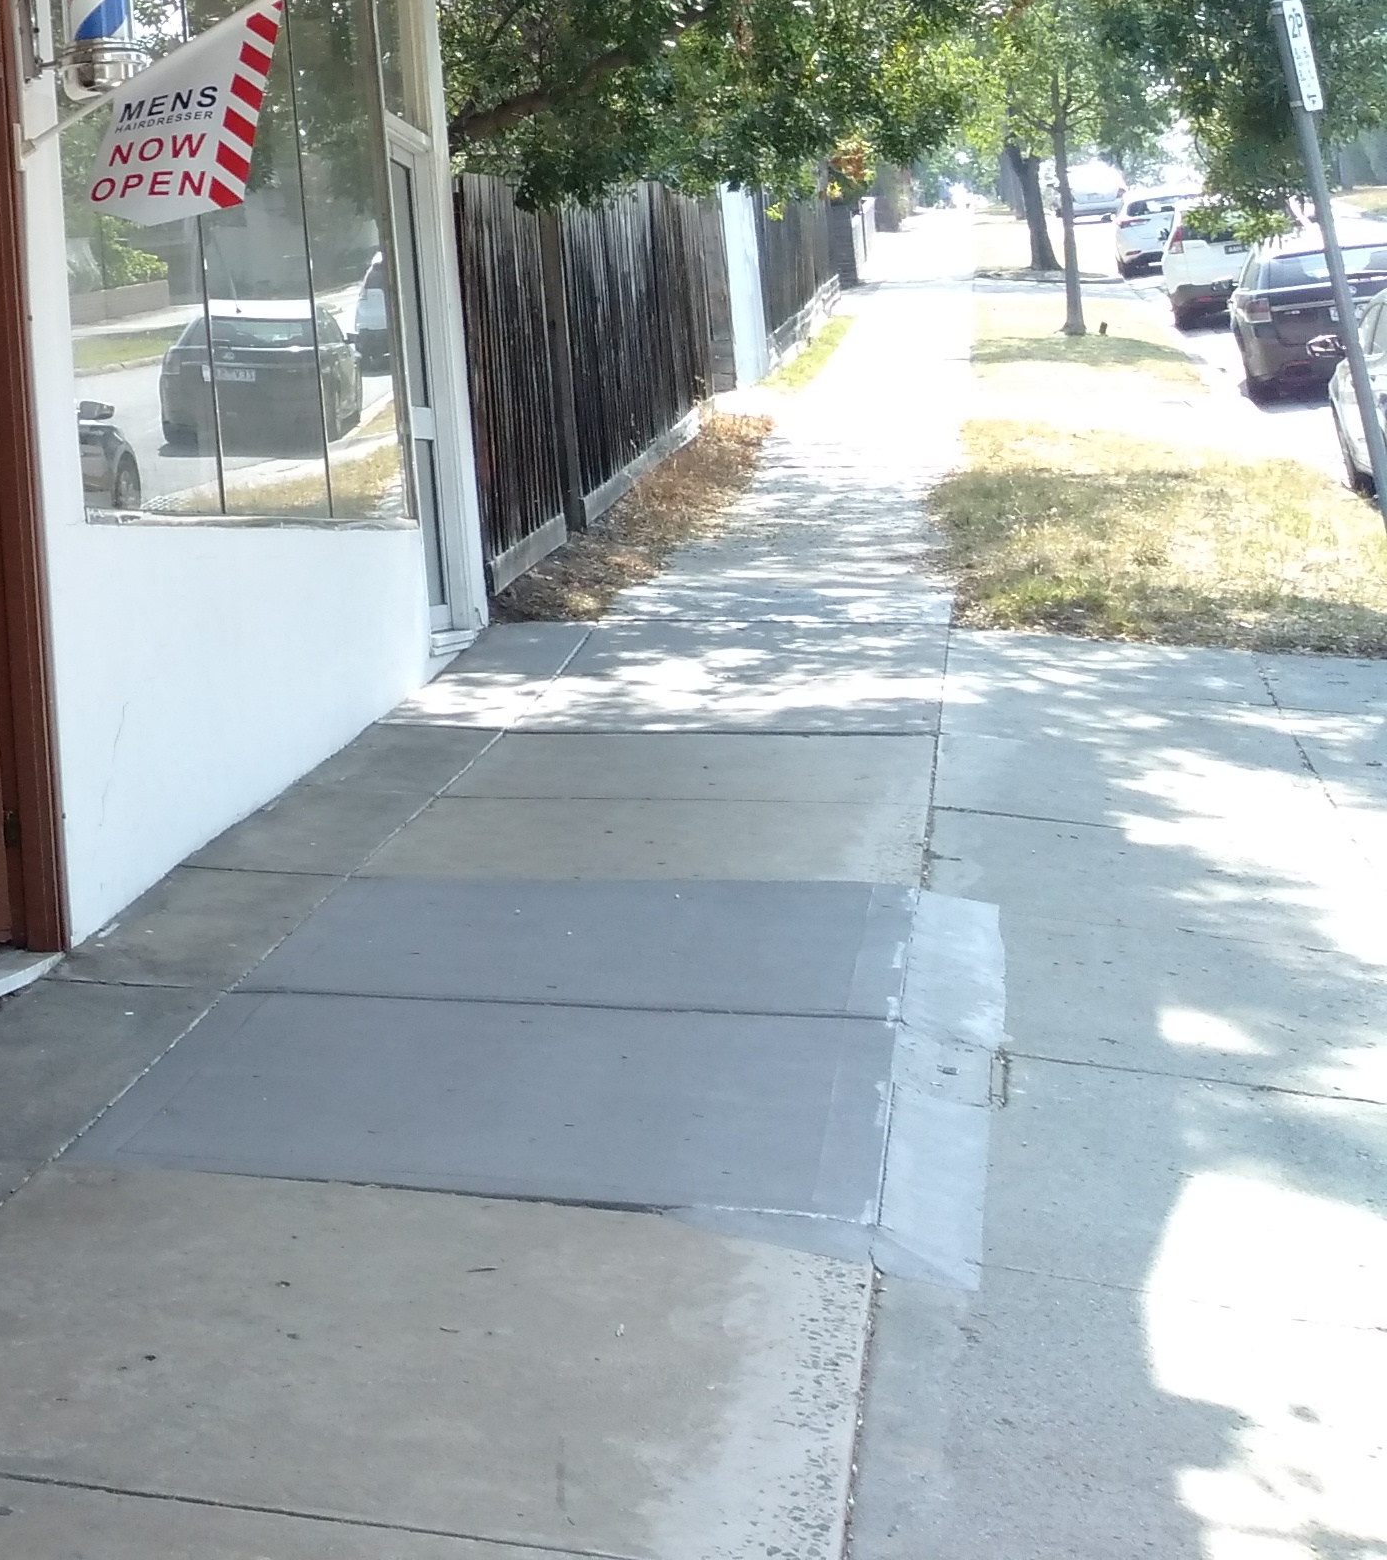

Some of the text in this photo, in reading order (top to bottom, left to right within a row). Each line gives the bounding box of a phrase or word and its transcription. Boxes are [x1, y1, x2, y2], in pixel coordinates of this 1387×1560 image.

[1288, 13, 1303, 38] 2P
[119, 86, 219, 123] MENS
[114, 110, 213, 134] HAIRDRESSER
[109, 133, 207, 167] NOW
[91, 170, 204, 202] OPEN
